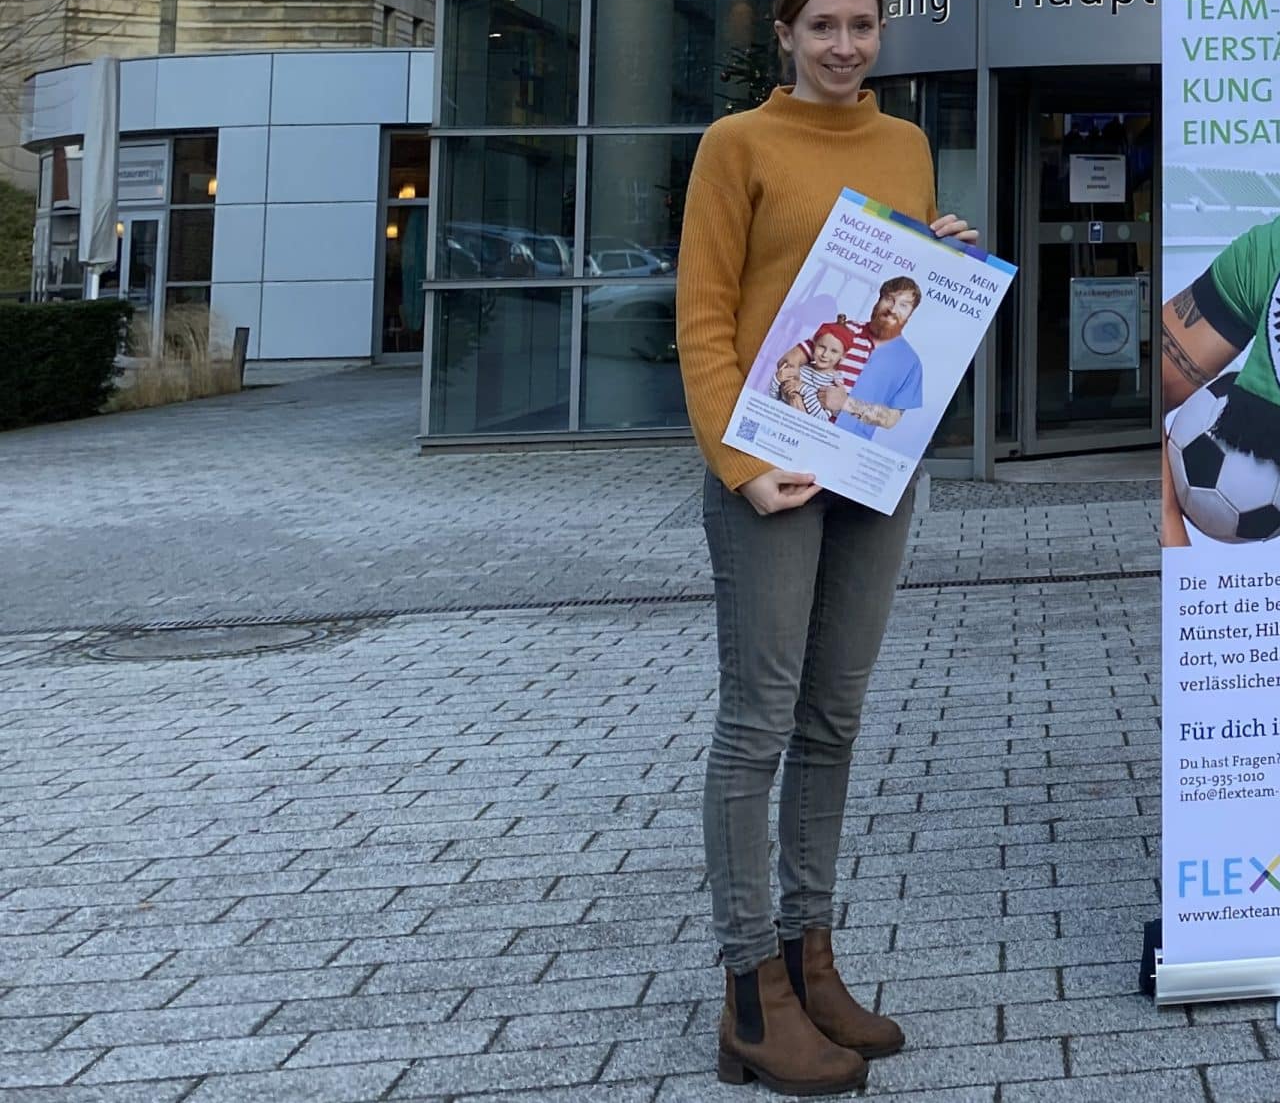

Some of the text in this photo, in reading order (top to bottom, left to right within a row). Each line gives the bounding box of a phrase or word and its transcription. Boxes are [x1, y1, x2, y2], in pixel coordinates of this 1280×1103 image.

[1183, 78, 1272, 103] KUNG
[840, 213, 893, 244] NACH DER
[825, 241, 883, 274] SPIELPLATZ!
[832, 227, 916, 272] SCHULE AUF DEN
[927, 271, 992, 307] DIENSTPLAN
[969, 273, 998, 293] MEIN
[926, 287, 983, 321] KANN DAS.
[1179, 576, 1207, 591] Die
[1179, 599, 1228, 616] sofort
[1234, 598, 1260, 613] die
[1179, 626, 1252, 641] Münster,
[1179, 651, 1217, 667] dort,
[1222, 653, 1245, 666] wo
[1179, 721, 1215, 741] Für
[1221, 718, 1266, 739] dich
[1179, 758, 1198, 769] Du
[1202, 756, 1229, 769] hast
[1179, 772, 1265, 787] 0251-935-1010
